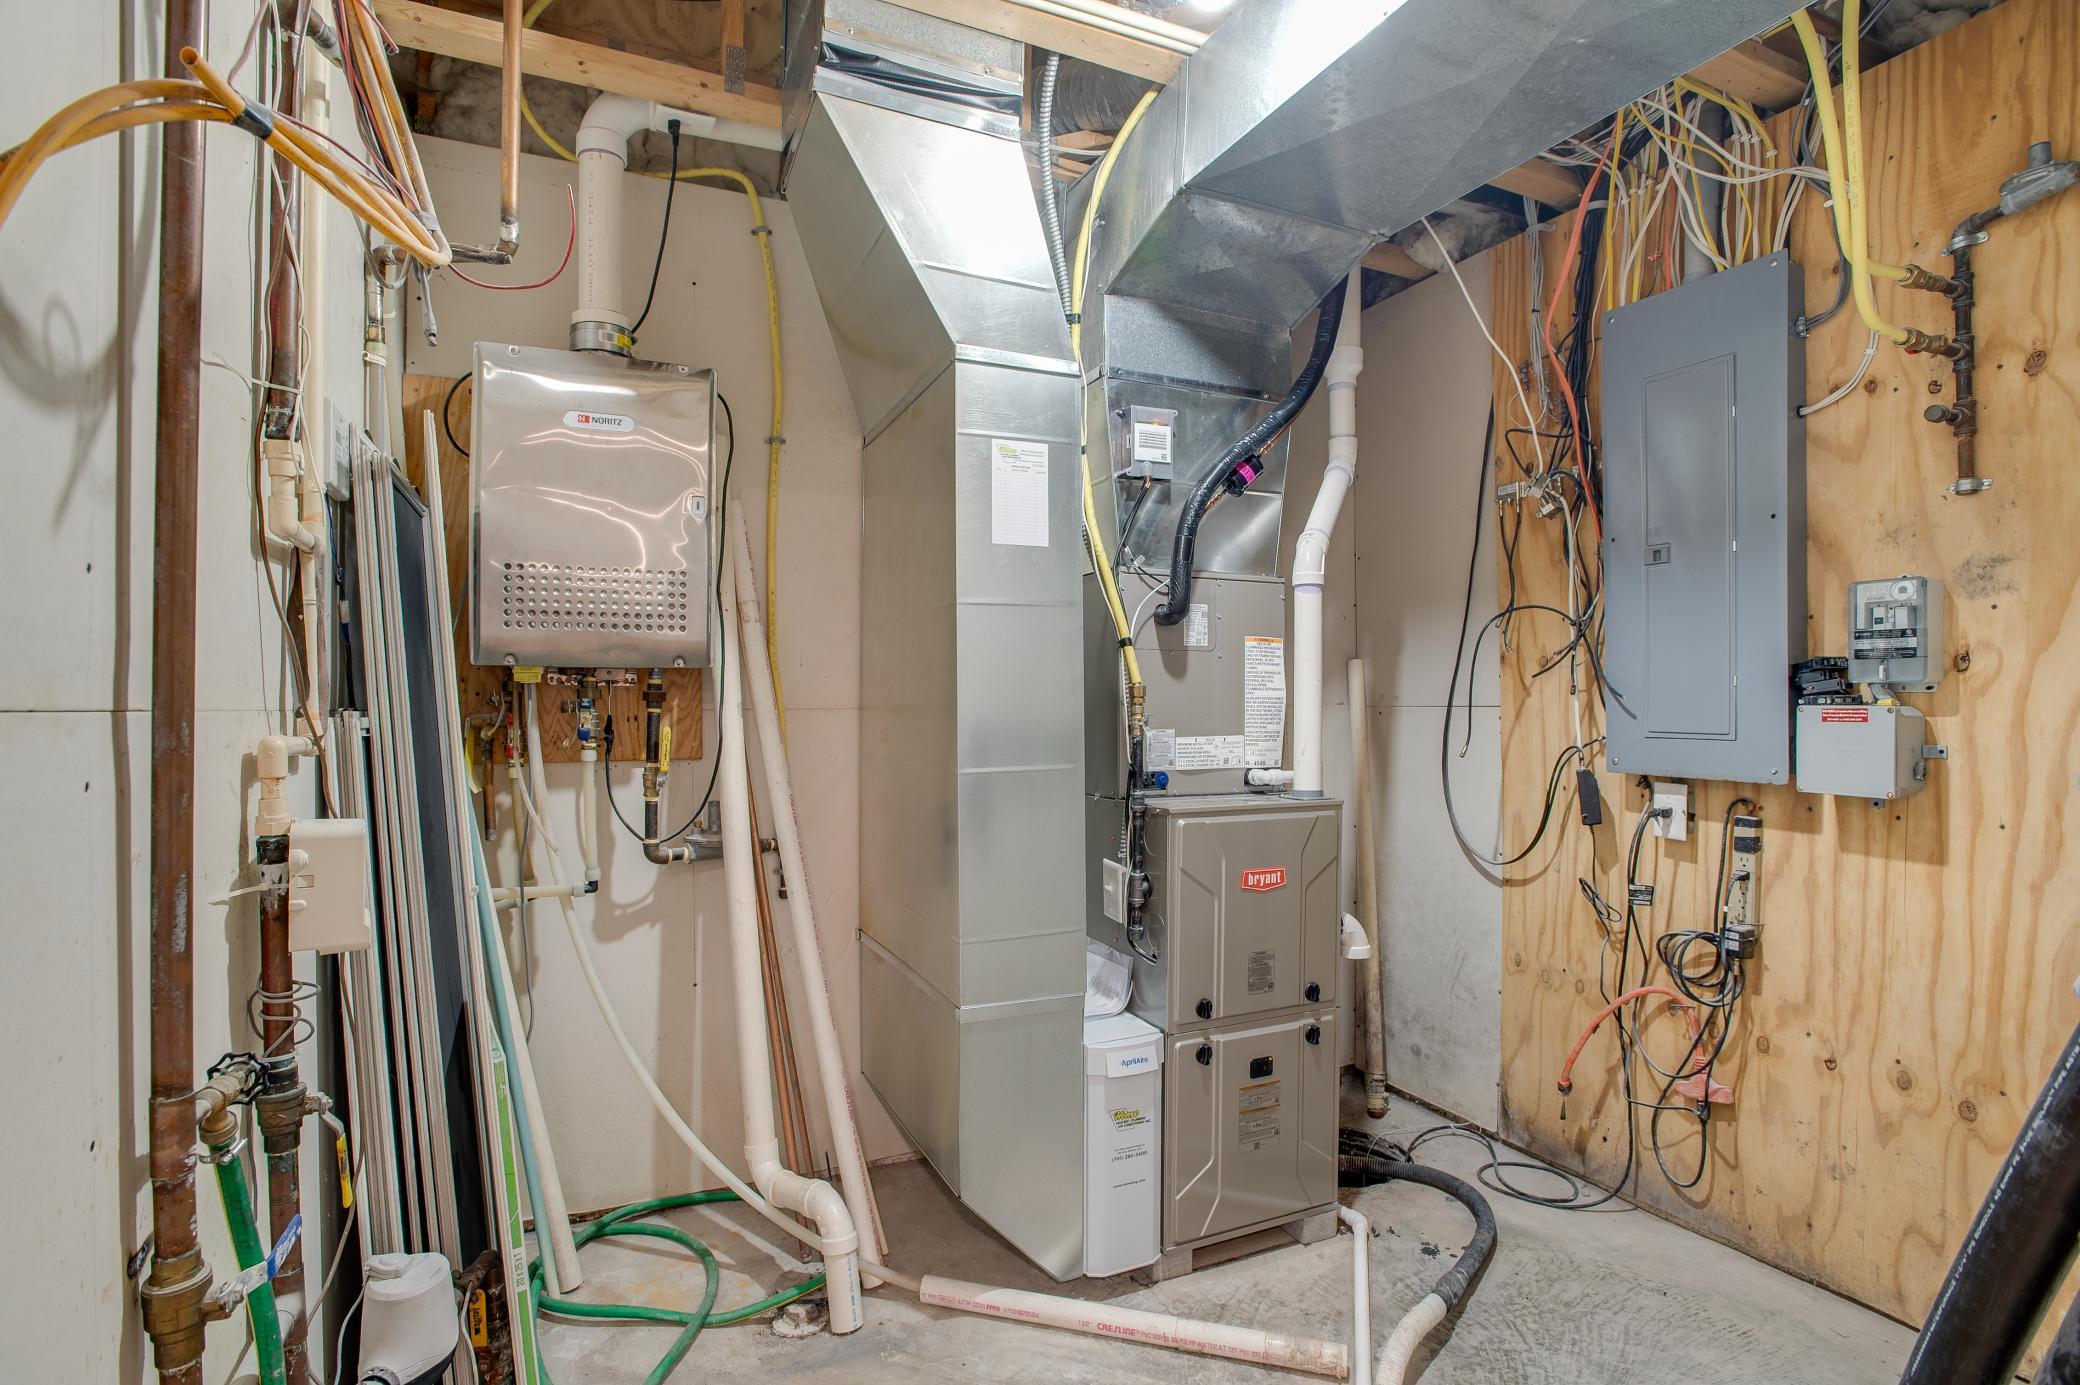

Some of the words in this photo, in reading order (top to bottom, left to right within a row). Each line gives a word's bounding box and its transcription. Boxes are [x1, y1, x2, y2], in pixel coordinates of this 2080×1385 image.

[591, 416, 623, 426] NORITZ
[1248, 871, 1281, 887] bryant
[1121, 1056, 1149, 1068] AprilAire
[1114, 1110, 1139, 1121] Home
[515, 1262, 524, 1271] 25
[516, 1278, 525, 1287] 20
[1097, 1322, 1136, 1337] CRESLINE
